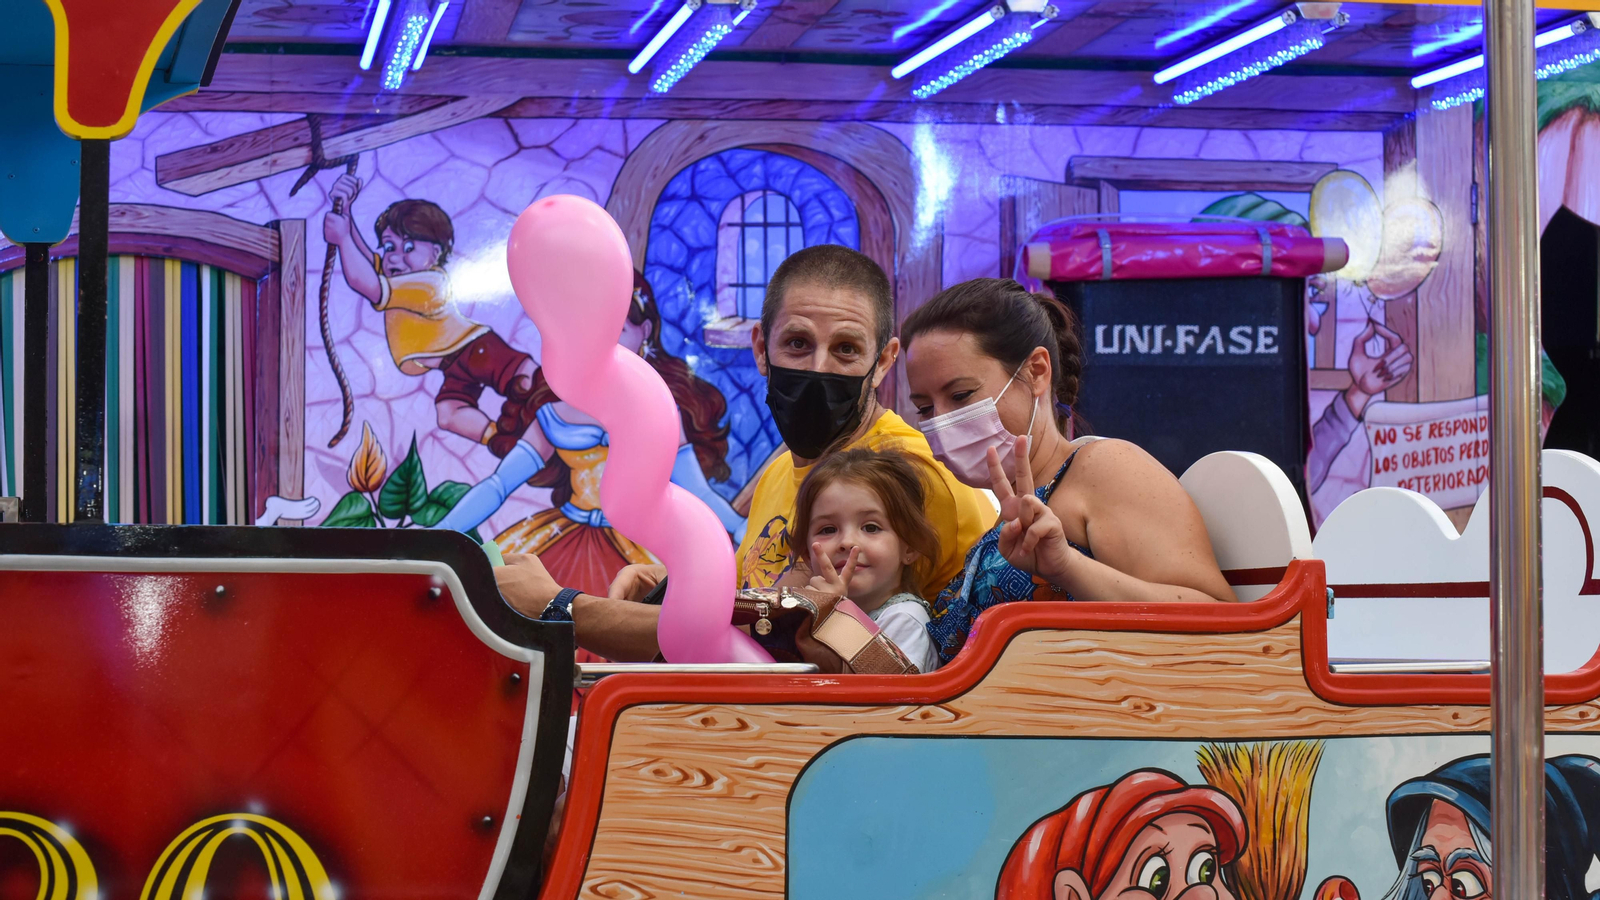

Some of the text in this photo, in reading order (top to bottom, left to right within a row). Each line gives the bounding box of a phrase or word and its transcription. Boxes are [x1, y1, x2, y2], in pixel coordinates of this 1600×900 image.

[1374, 427, 1397, 446] NO
[1403, 424, 1423, 442] SE
[1374, 454, 1398, 475] LOS
[1402, 445, 1454, 470] OBJETOS
